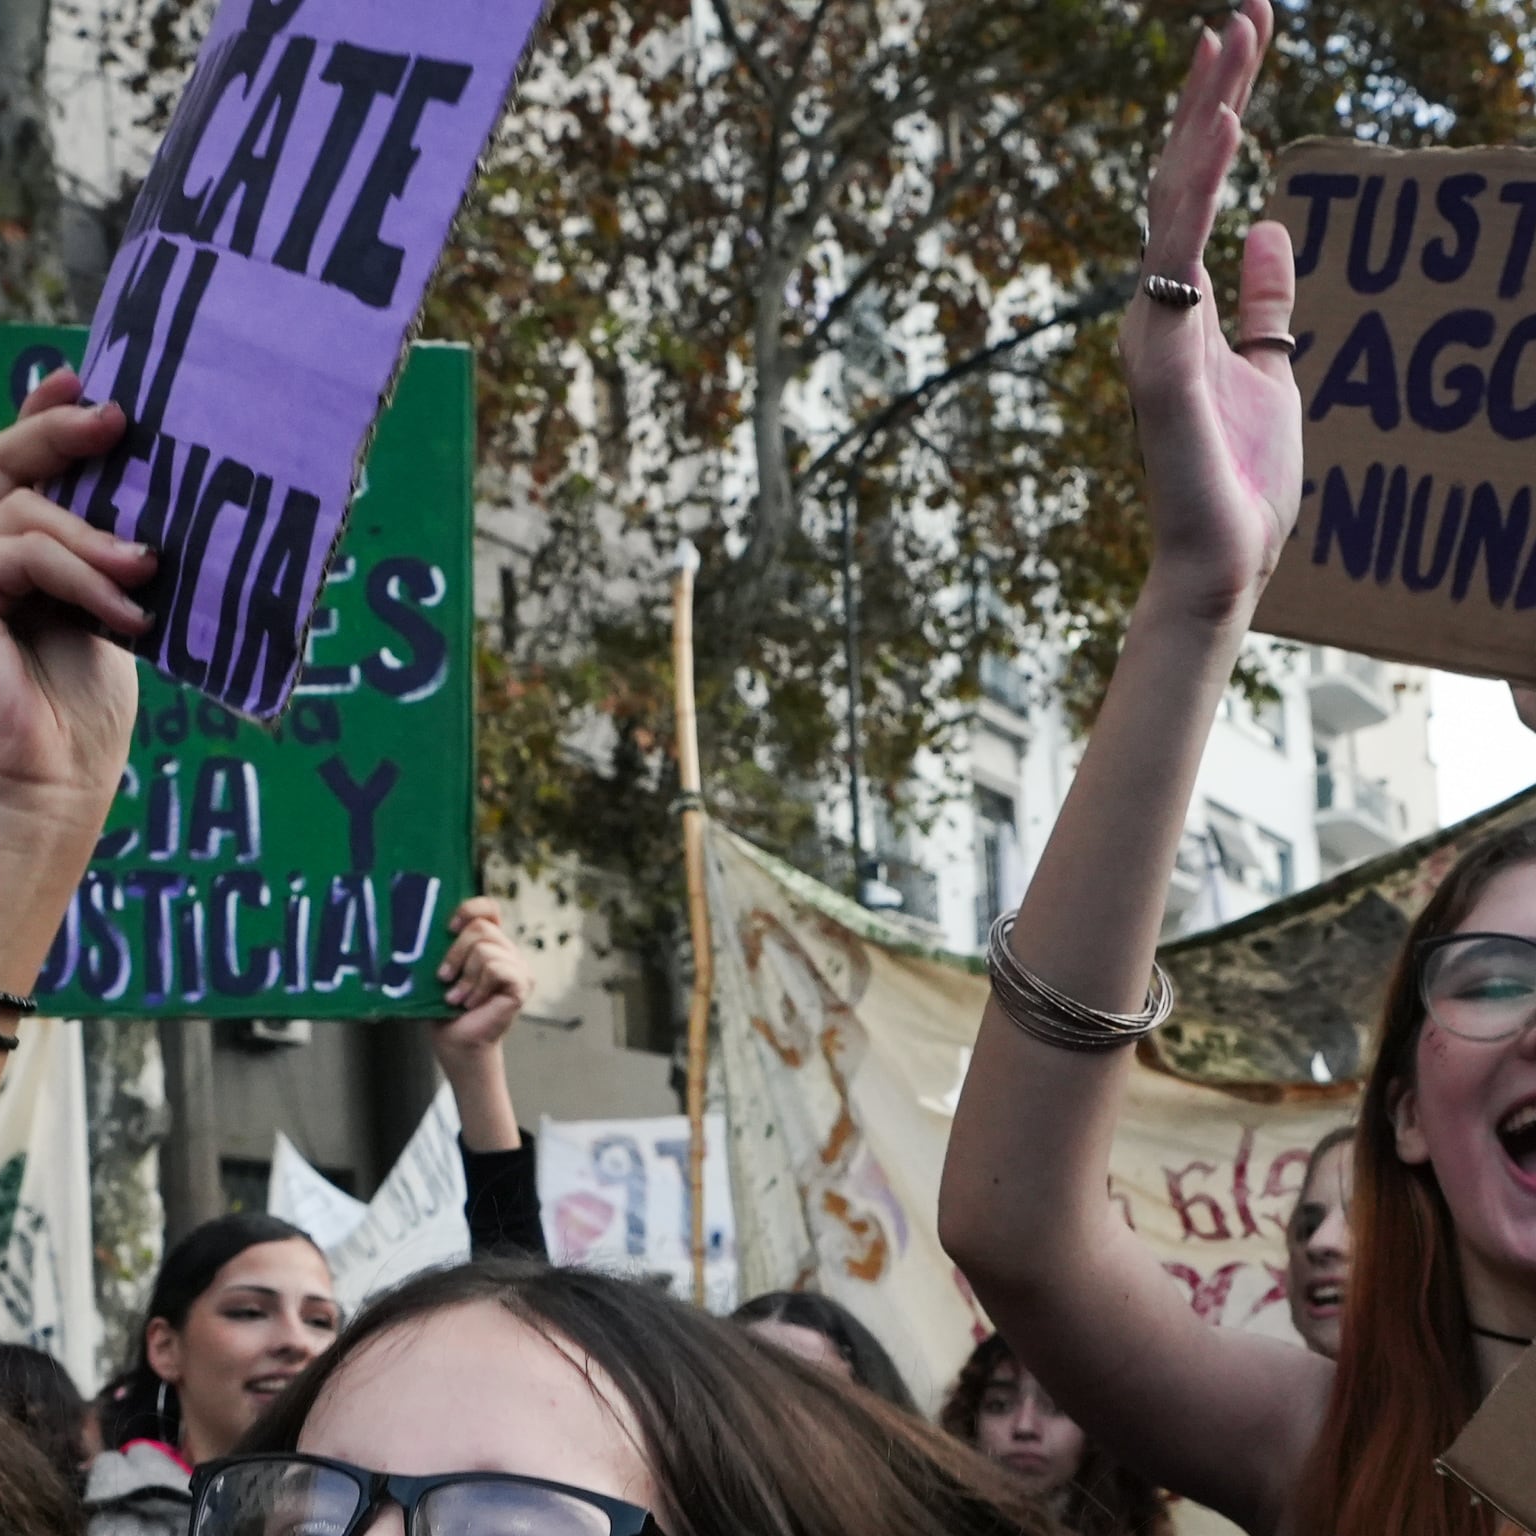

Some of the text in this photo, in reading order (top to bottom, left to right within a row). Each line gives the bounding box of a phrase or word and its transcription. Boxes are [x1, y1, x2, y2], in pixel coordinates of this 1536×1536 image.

[132, 34, 474, 309] CATE
[54, 430, 322, 718] ENCIA
[318, 755, 403, 872] Y
